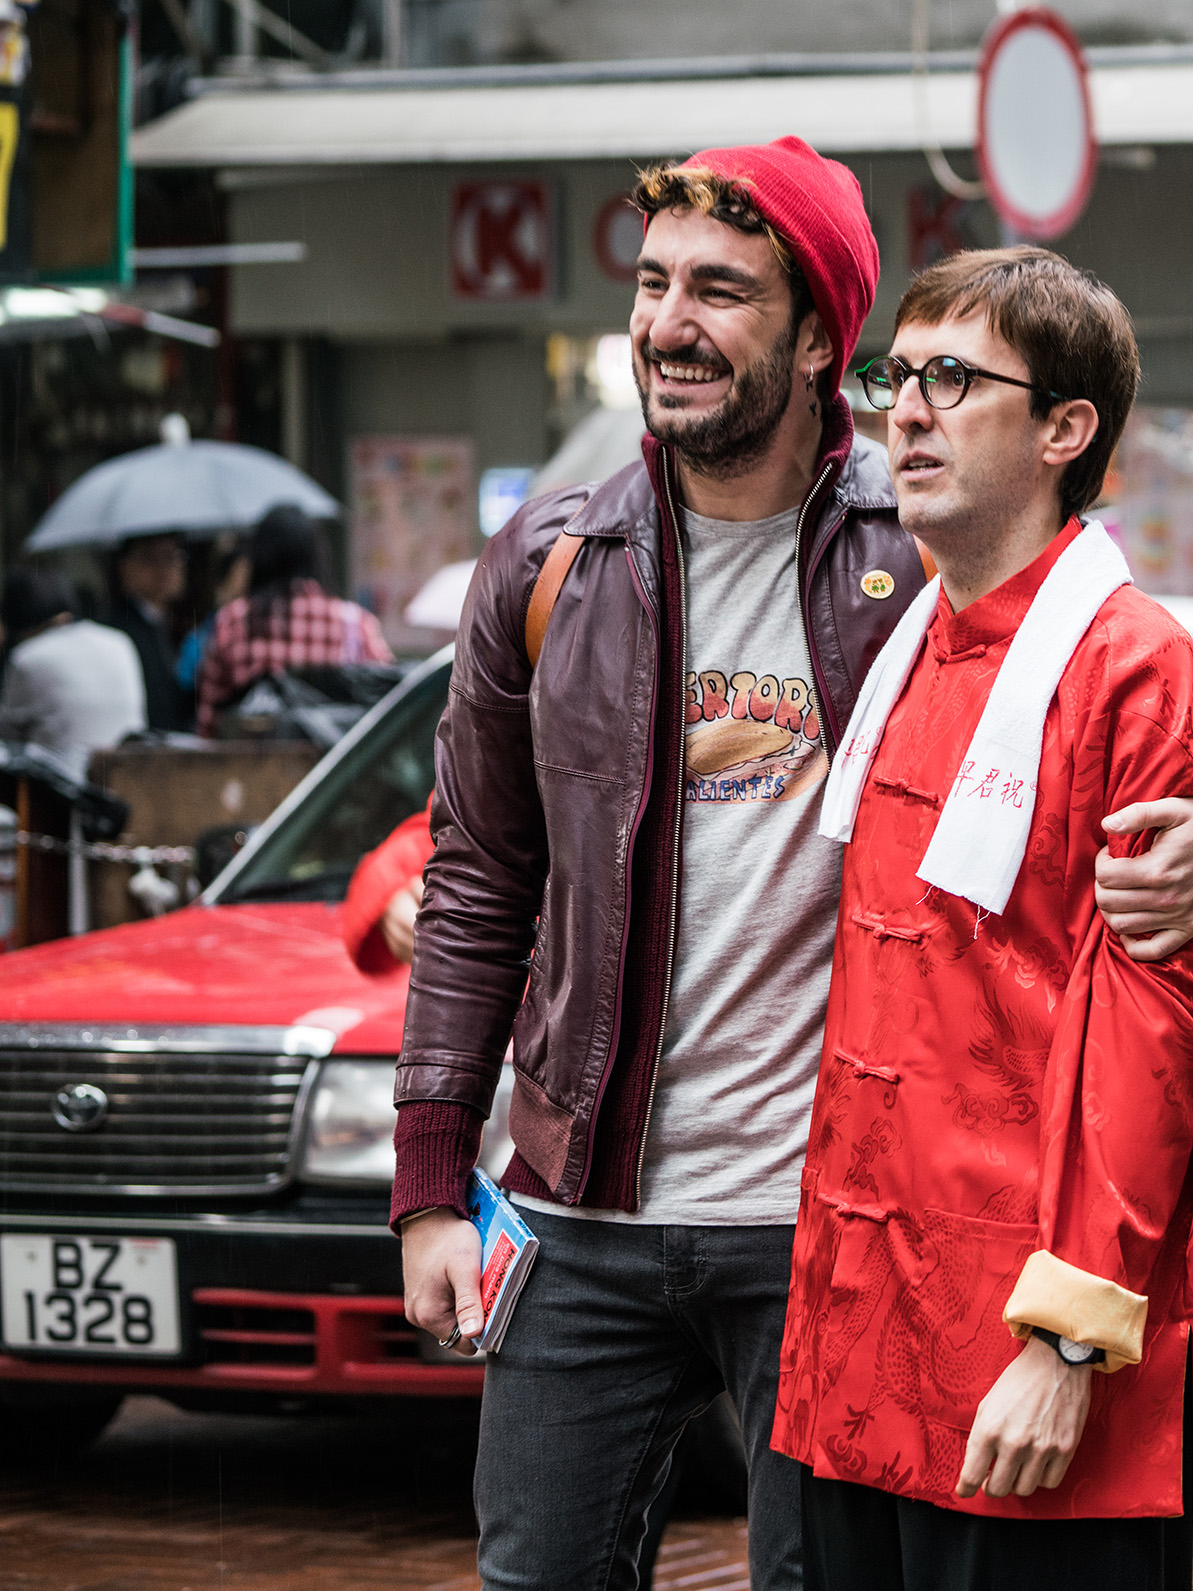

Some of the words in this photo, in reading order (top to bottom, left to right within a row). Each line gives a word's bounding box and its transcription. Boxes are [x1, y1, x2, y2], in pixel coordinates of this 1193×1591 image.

[53, 1241, 123, 1291] BZ
[484, 1273, 496, 1299] mano
[495, 1248, 515, 1289] HONG
[24, 1290, 155, 1345] 1328
